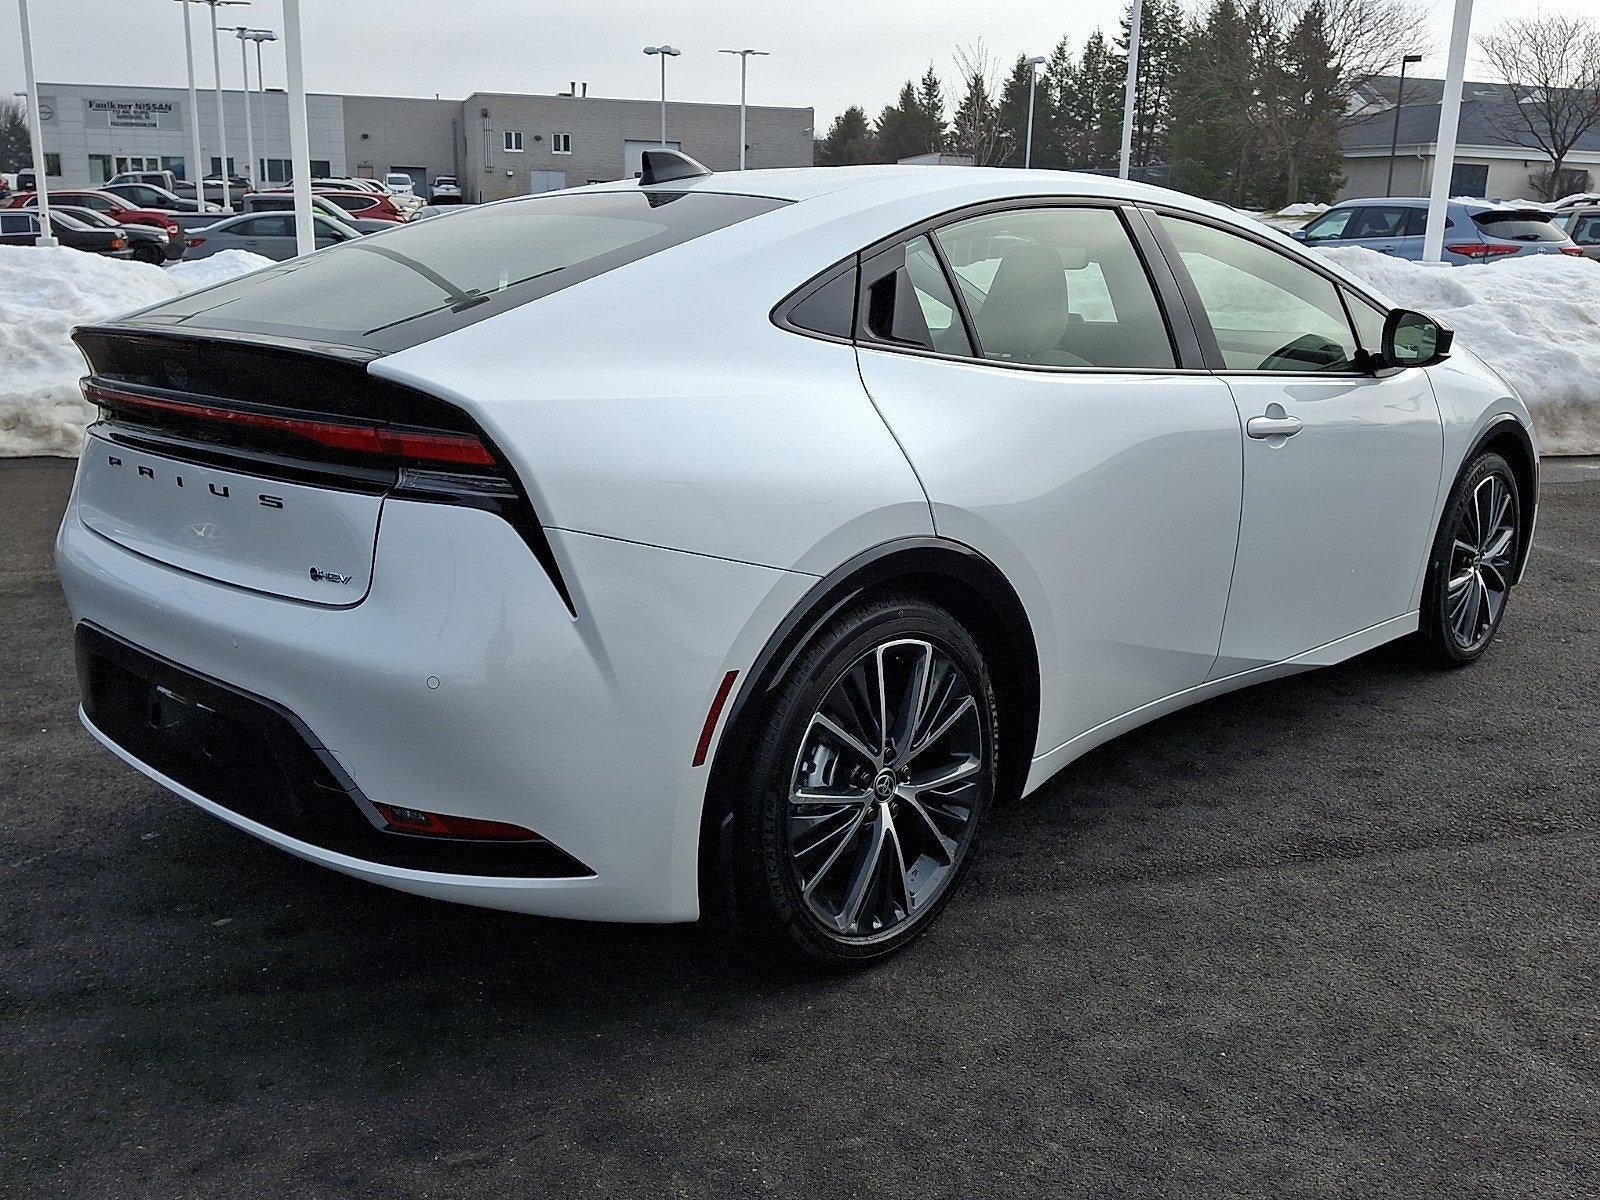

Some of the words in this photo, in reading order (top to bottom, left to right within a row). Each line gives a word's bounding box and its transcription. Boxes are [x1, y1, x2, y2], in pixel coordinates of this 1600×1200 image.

[89, 100, 134, 110] Faulkner
[135, 102, 172, 111] NISSAN
[108, 455, 284, 509] PRIUS
[325, 572, 353, 585] HEV
